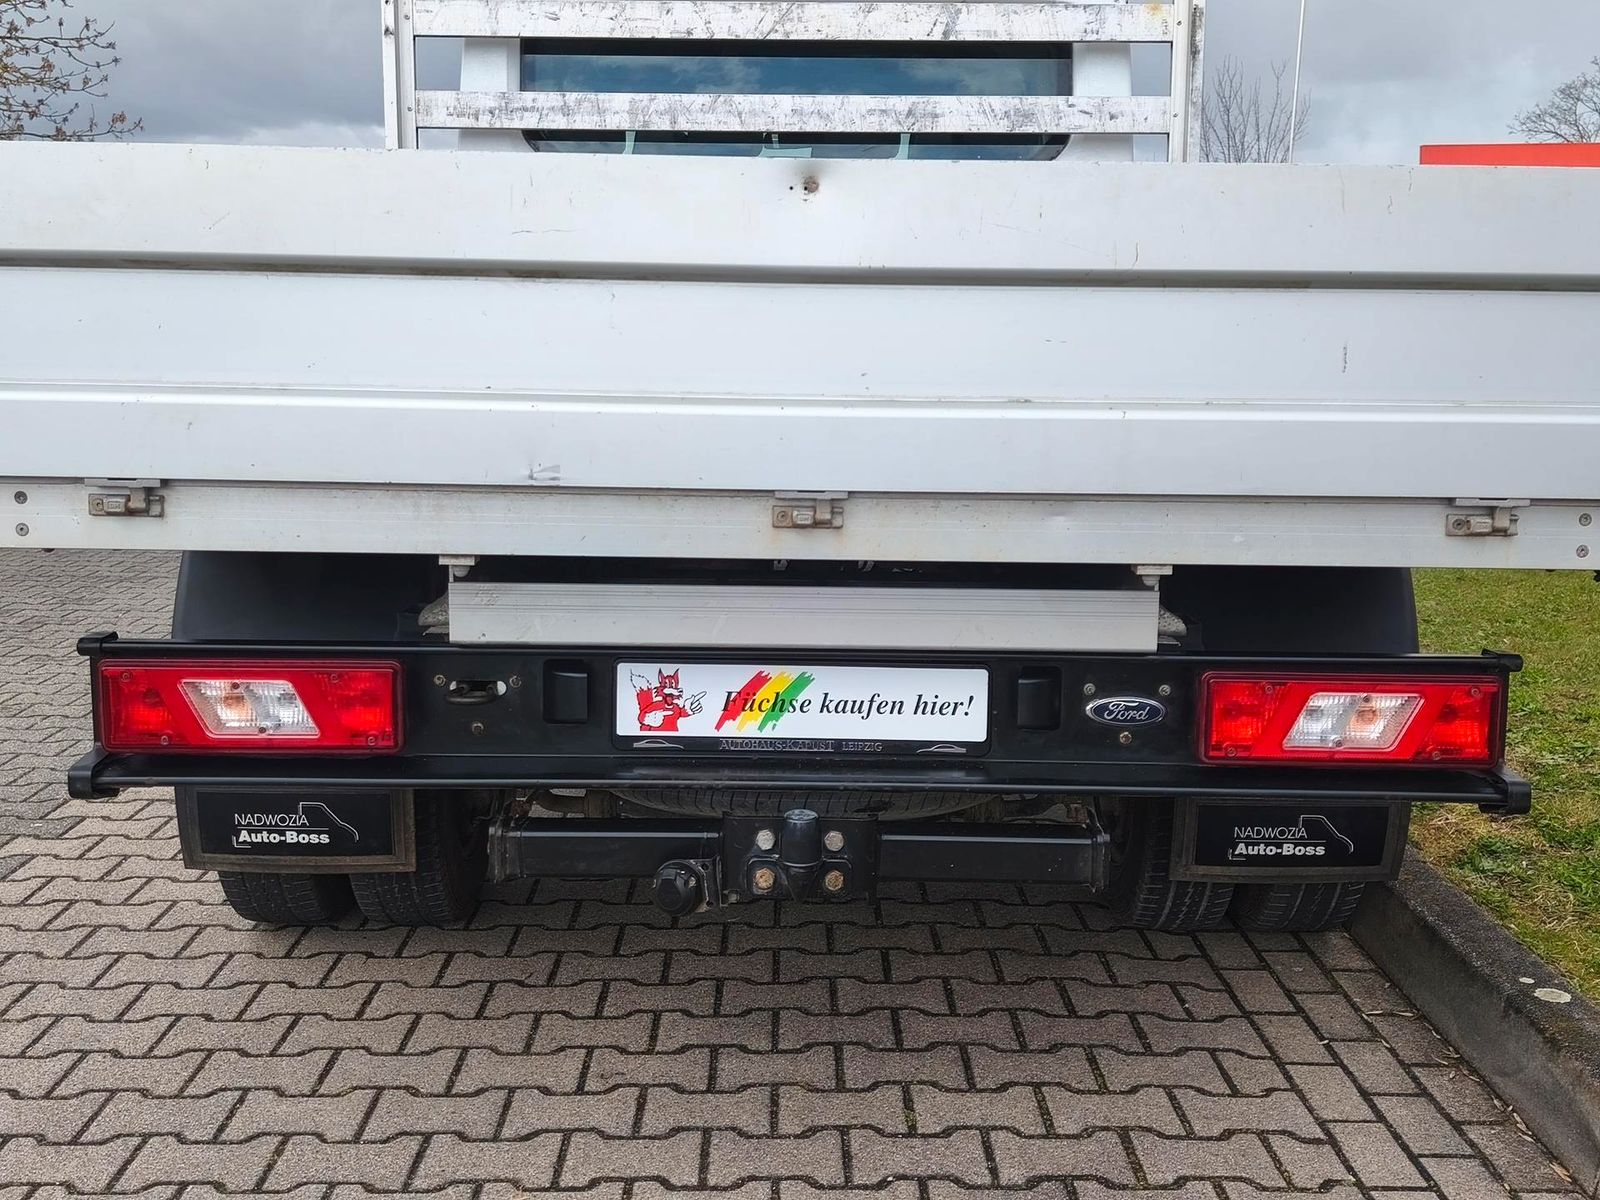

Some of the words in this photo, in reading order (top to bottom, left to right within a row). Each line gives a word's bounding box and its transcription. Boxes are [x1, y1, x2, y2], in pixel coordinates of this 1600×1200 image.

[721, 690, 812, 713] Füchse
[819, 692, 905, 720] kaufen
[913, 694, 975, 716] hier!
[1103, 701, 1151, 720] Ford
[842, 741, 883, 752] LEIPZIG
[234, 813, 309, 826] NADWOZIA
[238, 829, 330, 844] Auto-Boss
[1234, 826, 1308, 839] NADWOZIA
[1234, 842, 1326, 856] Auto-Boss
